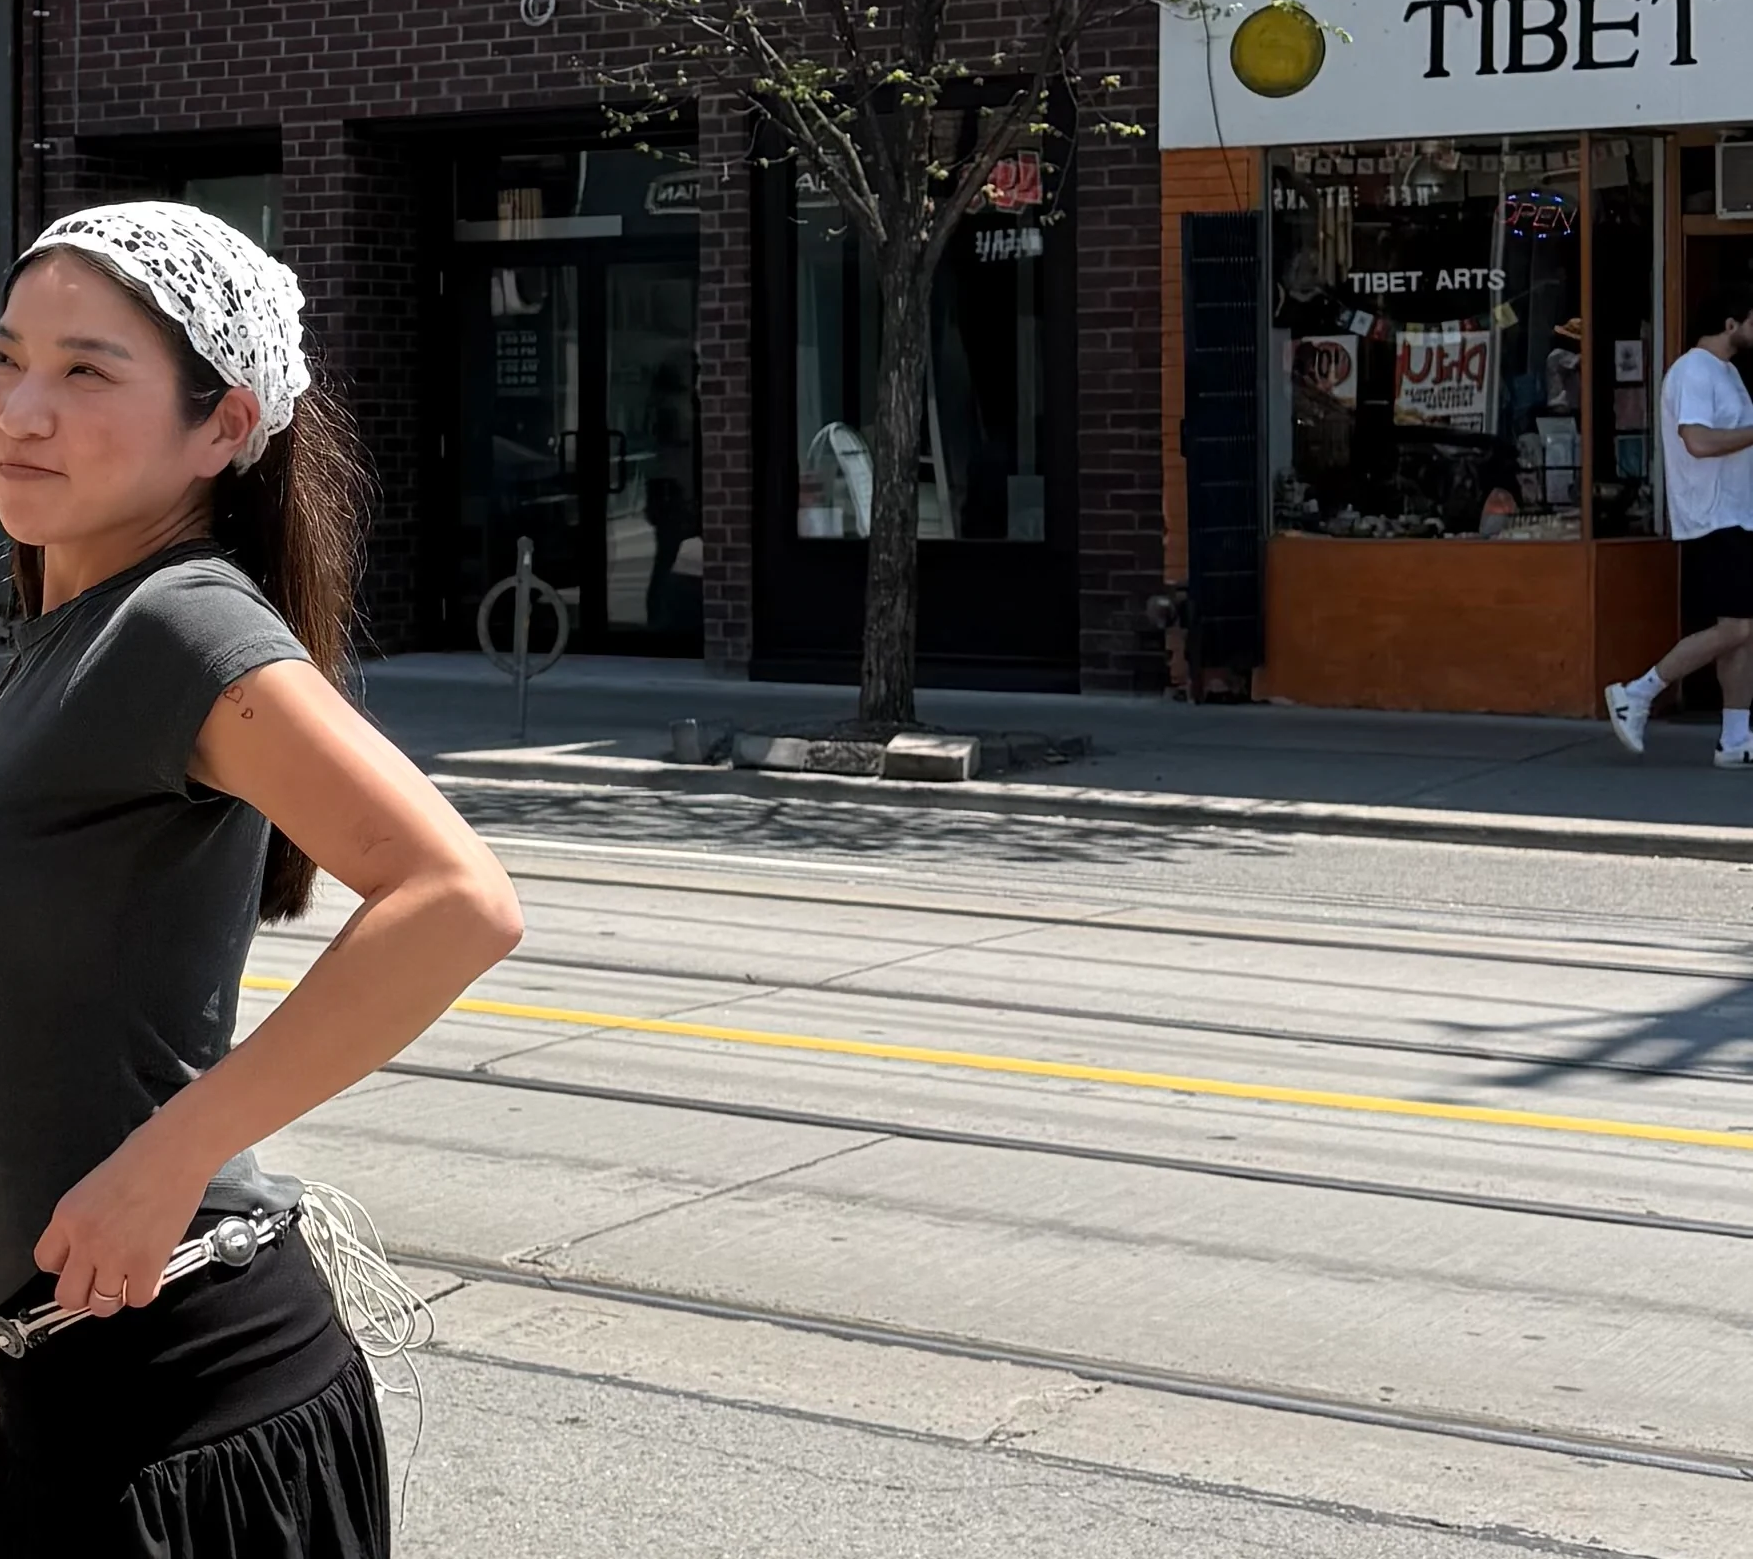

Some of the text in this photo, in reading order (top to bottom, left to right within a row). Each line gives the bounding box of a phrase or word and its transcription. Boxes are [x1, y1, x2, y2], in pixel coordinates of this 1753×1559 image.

[1495, 200, 1578, 233] OPEN
[1348, 268, 1507, 294] TIBET ARTS
